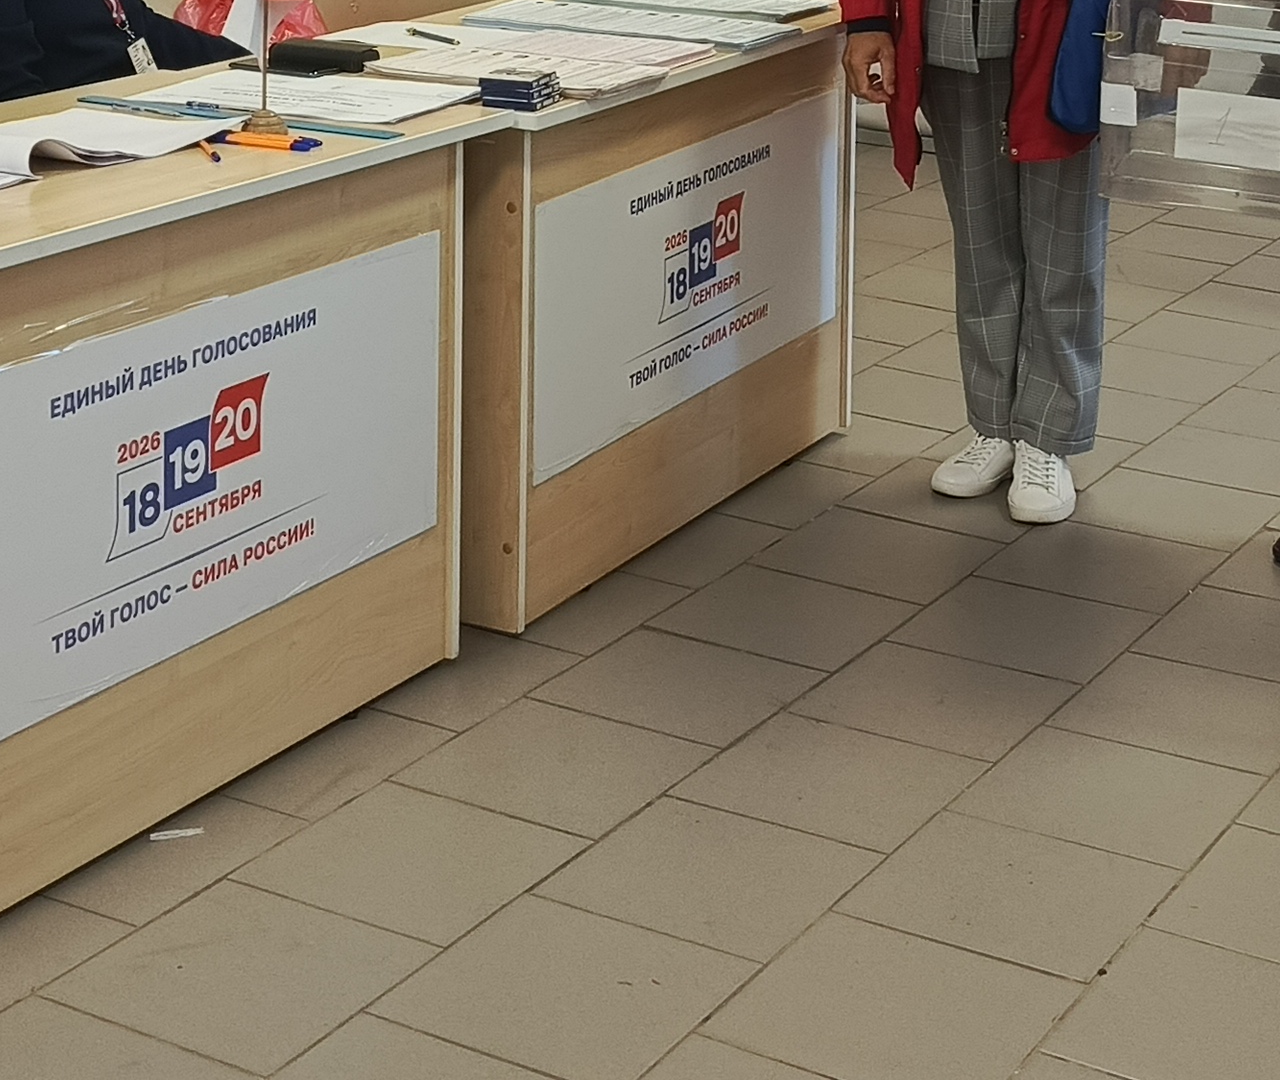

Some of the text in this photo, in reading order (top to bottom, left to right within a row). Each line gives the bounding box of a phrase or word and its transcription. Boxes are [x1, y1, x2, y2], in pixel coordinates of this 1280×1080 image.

[1208, 107, 1231, 147] 1
[630, 144, 770, 215] ЕДИНЫЙ ДЕНЬ ГОЛОСОВАНИЯ
[665, 229, 687, 252] 2026
[667, 209, 738, 304] 18 19 20
[692, 271, 740, 306] СЕНТЯБРЯ
[50, 308, 317, 419] ЕДИНЫЙ ДЕНЬ ГОЛОСОВАНИЯ
[629, 358, 658, 389] ТВОЙ
[659, 344, 692, 373] ГОЛОС
[701, 325, 727, 350] СИЛА
[729, 303, 769, 336] РОССИИ!
[117, 431, 161, 464] 2026
[123, 397, 257, 534] 18 19 20
[172, 479, 262, 533] СЕНТЯБРЯ
[51, 610, 104, 654] ТВОЙ
[110, 584, 171, 629] ГОЛОС
[191, 553, 239, 590] СИЛА
[243, 518, 315, 567] РОССИИ!
